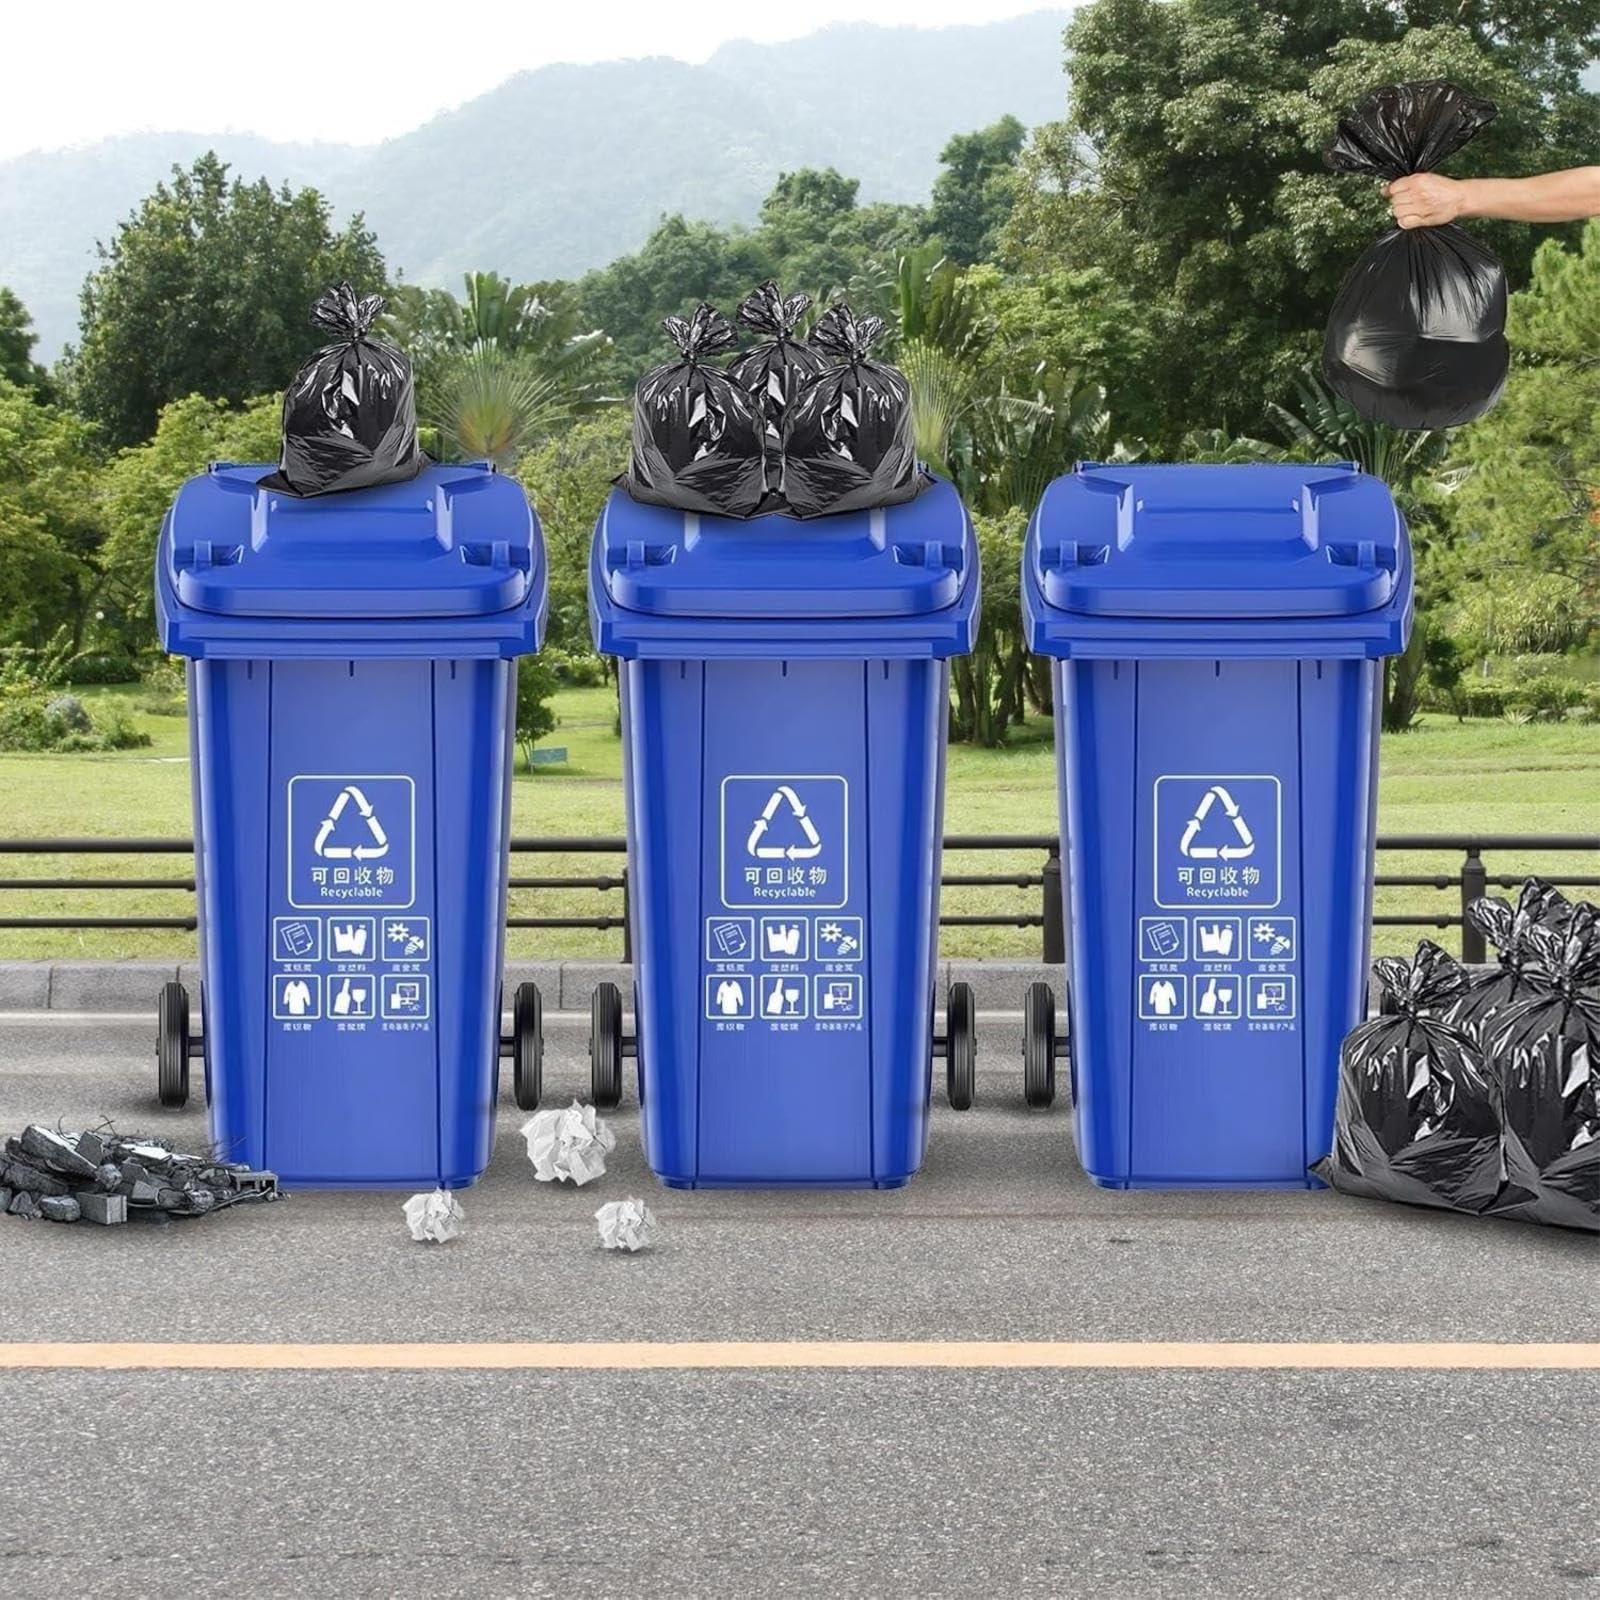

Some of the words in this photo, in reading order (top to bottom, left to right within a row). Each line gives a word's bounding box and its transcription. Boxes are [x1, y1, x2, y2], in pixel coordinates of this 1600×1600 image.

[310, 866, 394, 886] 可回收物
[744, 866, 827, 886] 可回收物
[1176, 866, 1260, 886] 可回收物
[320, 886, 384, 899] Recyclable
[753, 886, 816, 899] Recyclable
[1186, 886, 1250, 899] Recyclable
